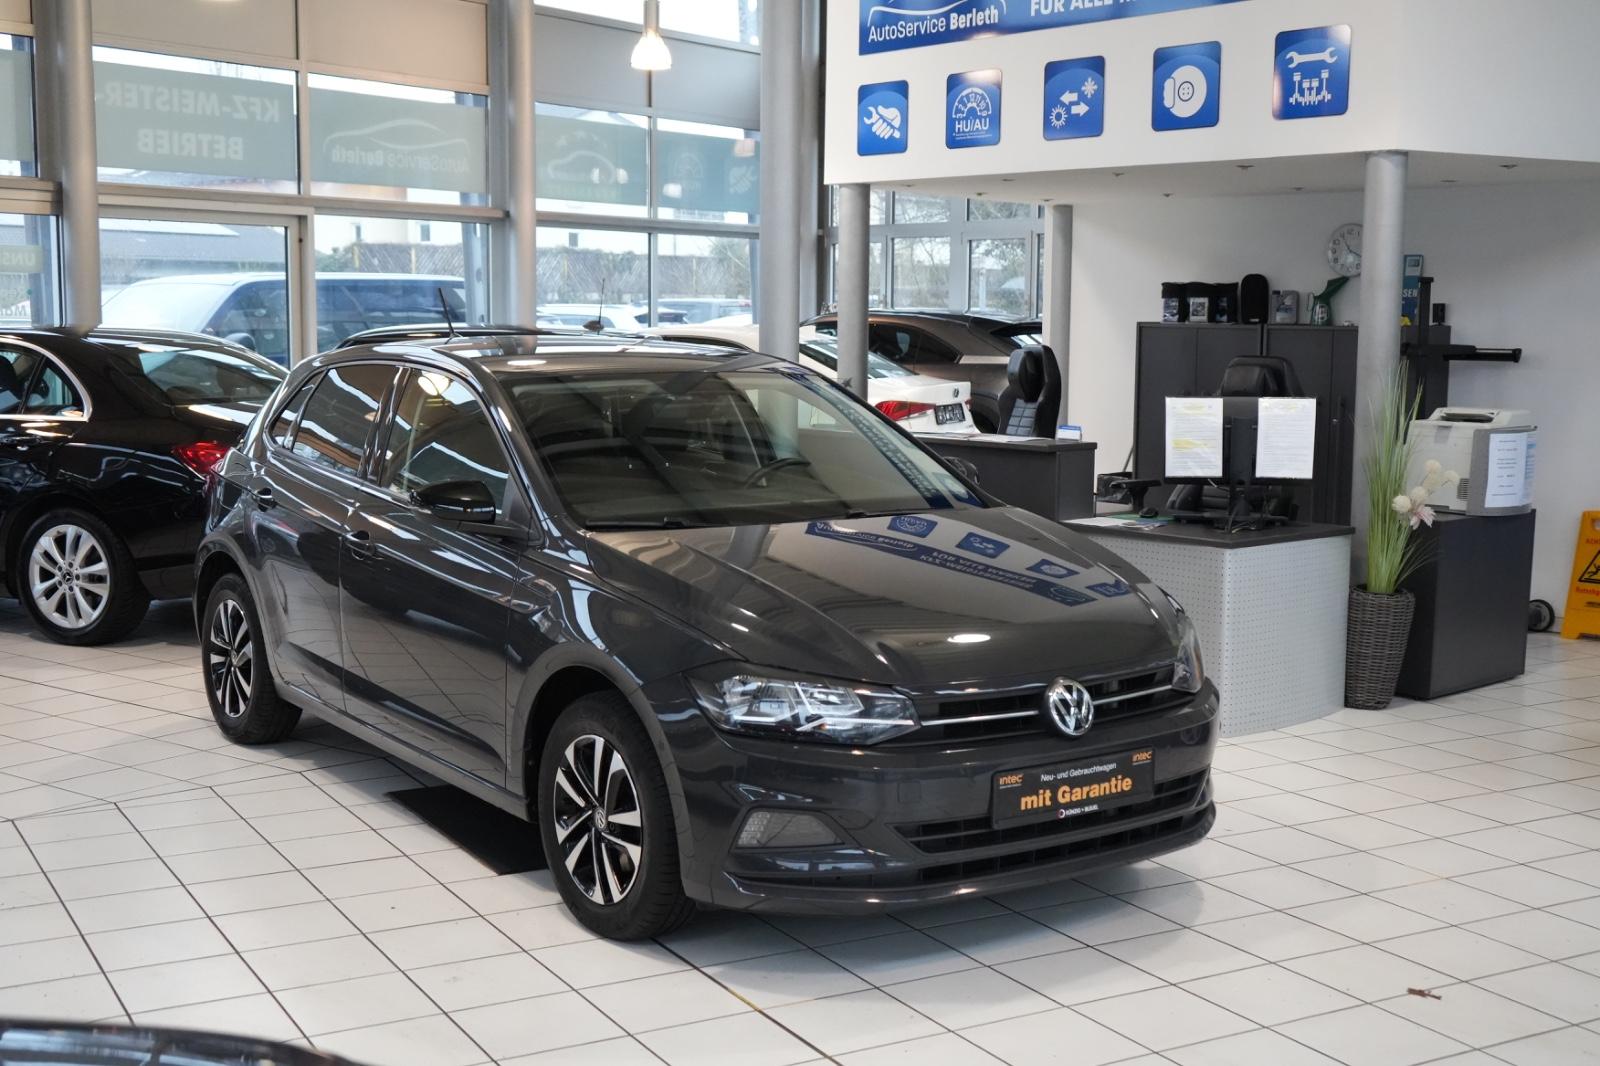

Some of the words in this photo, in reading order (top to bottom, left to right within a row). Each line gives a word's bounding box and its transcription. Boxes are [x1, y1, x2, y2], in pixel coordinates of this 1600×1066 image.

[868, 17, 946, 42] AutoService
[950, 5, 998, 30] Berleth
[955, 118, 989, 133] HU/AU
[1041, 773, 1056, 782] Neu-
[1057, 770, 1069, 780] und
[1069, 763, 1116, 777] Gebrauchtwagen
[1020, 789, 1052, 811] mit
[1057, 775, 1132, 804] Garantie
